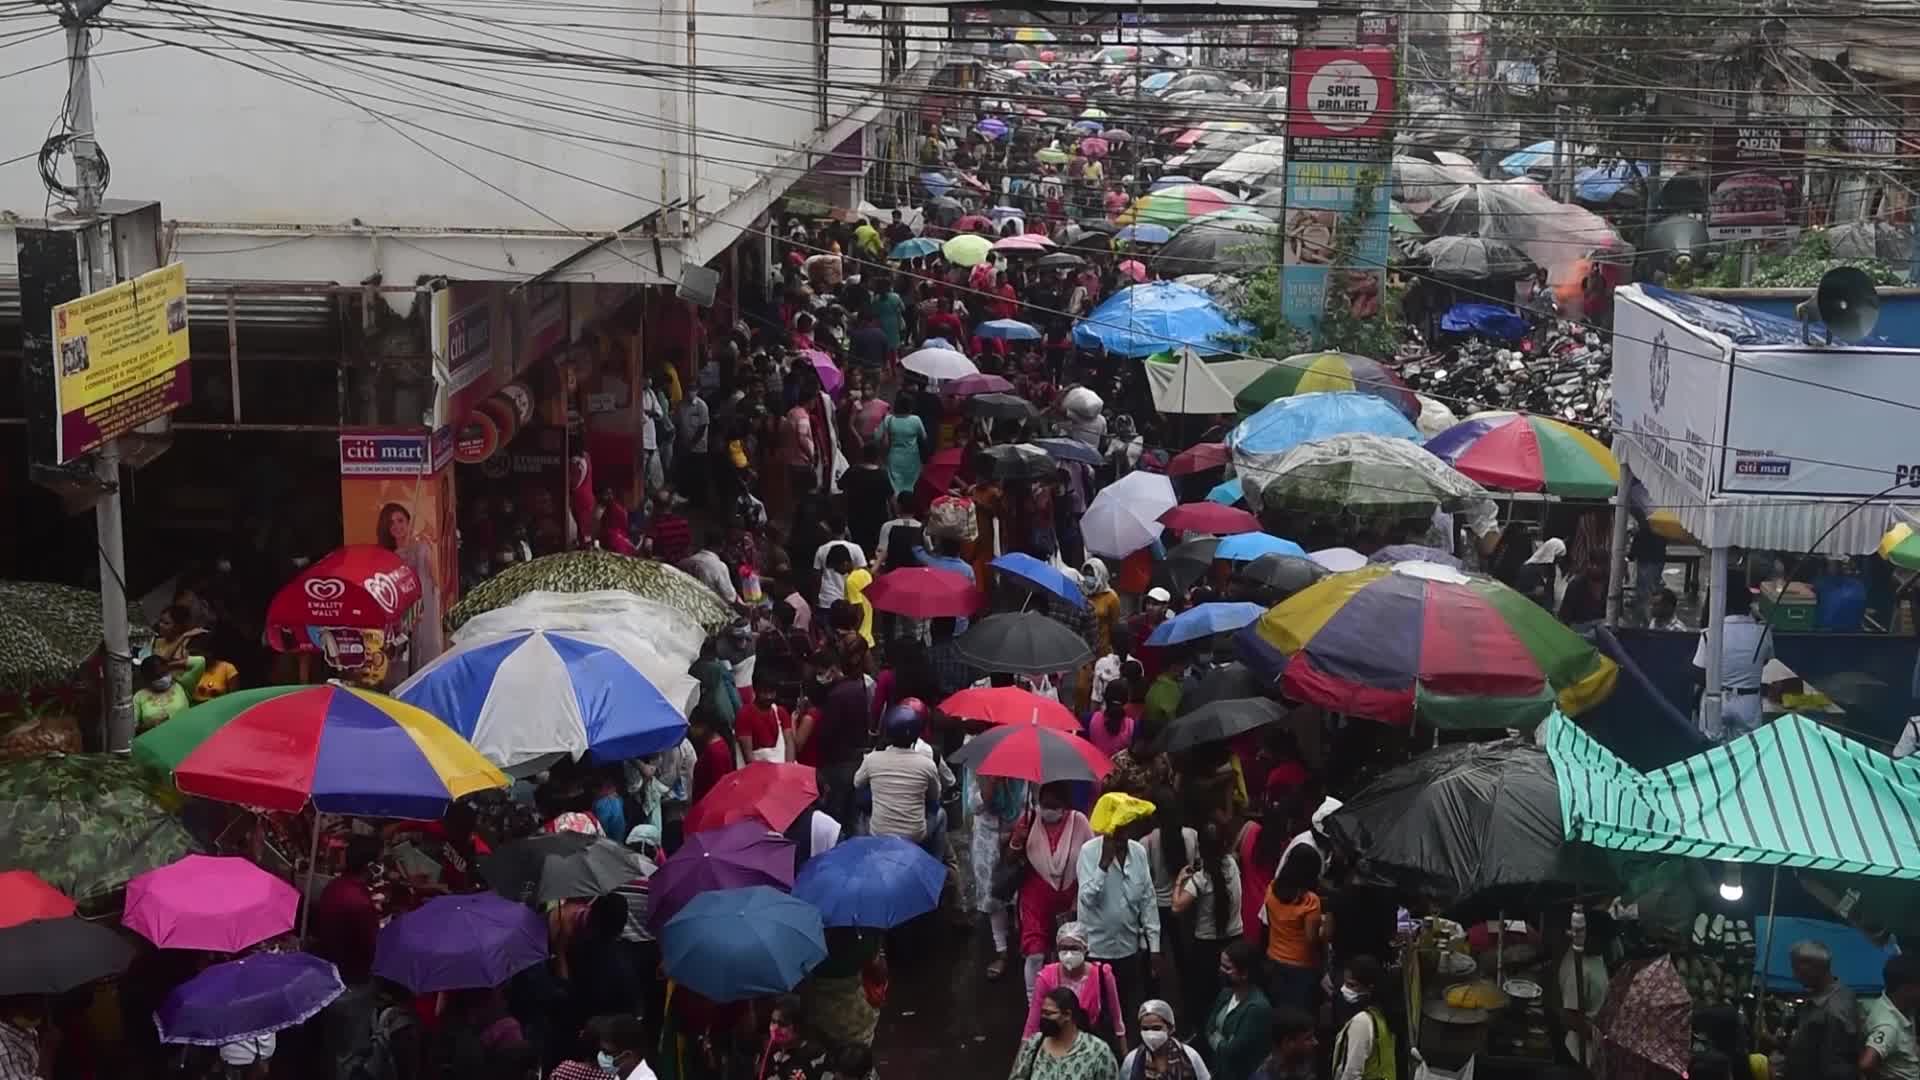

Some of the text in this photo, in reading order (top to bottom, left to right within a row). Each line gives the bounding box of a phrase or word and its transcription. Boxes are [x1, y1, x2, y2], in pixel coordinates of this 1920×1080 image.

[1327, 85, 1361, 97] SPICE
[1318, 100, 1369, 112] PROJECT
[1736, 138, 1781, 151] OPEN
[347, 440, 422, 458] citi mart
[1739, 462, 1788, 474] citi mart
[307, 601, 344, 609] KWALITY
[311, 609, 340, 617] WALL'S
